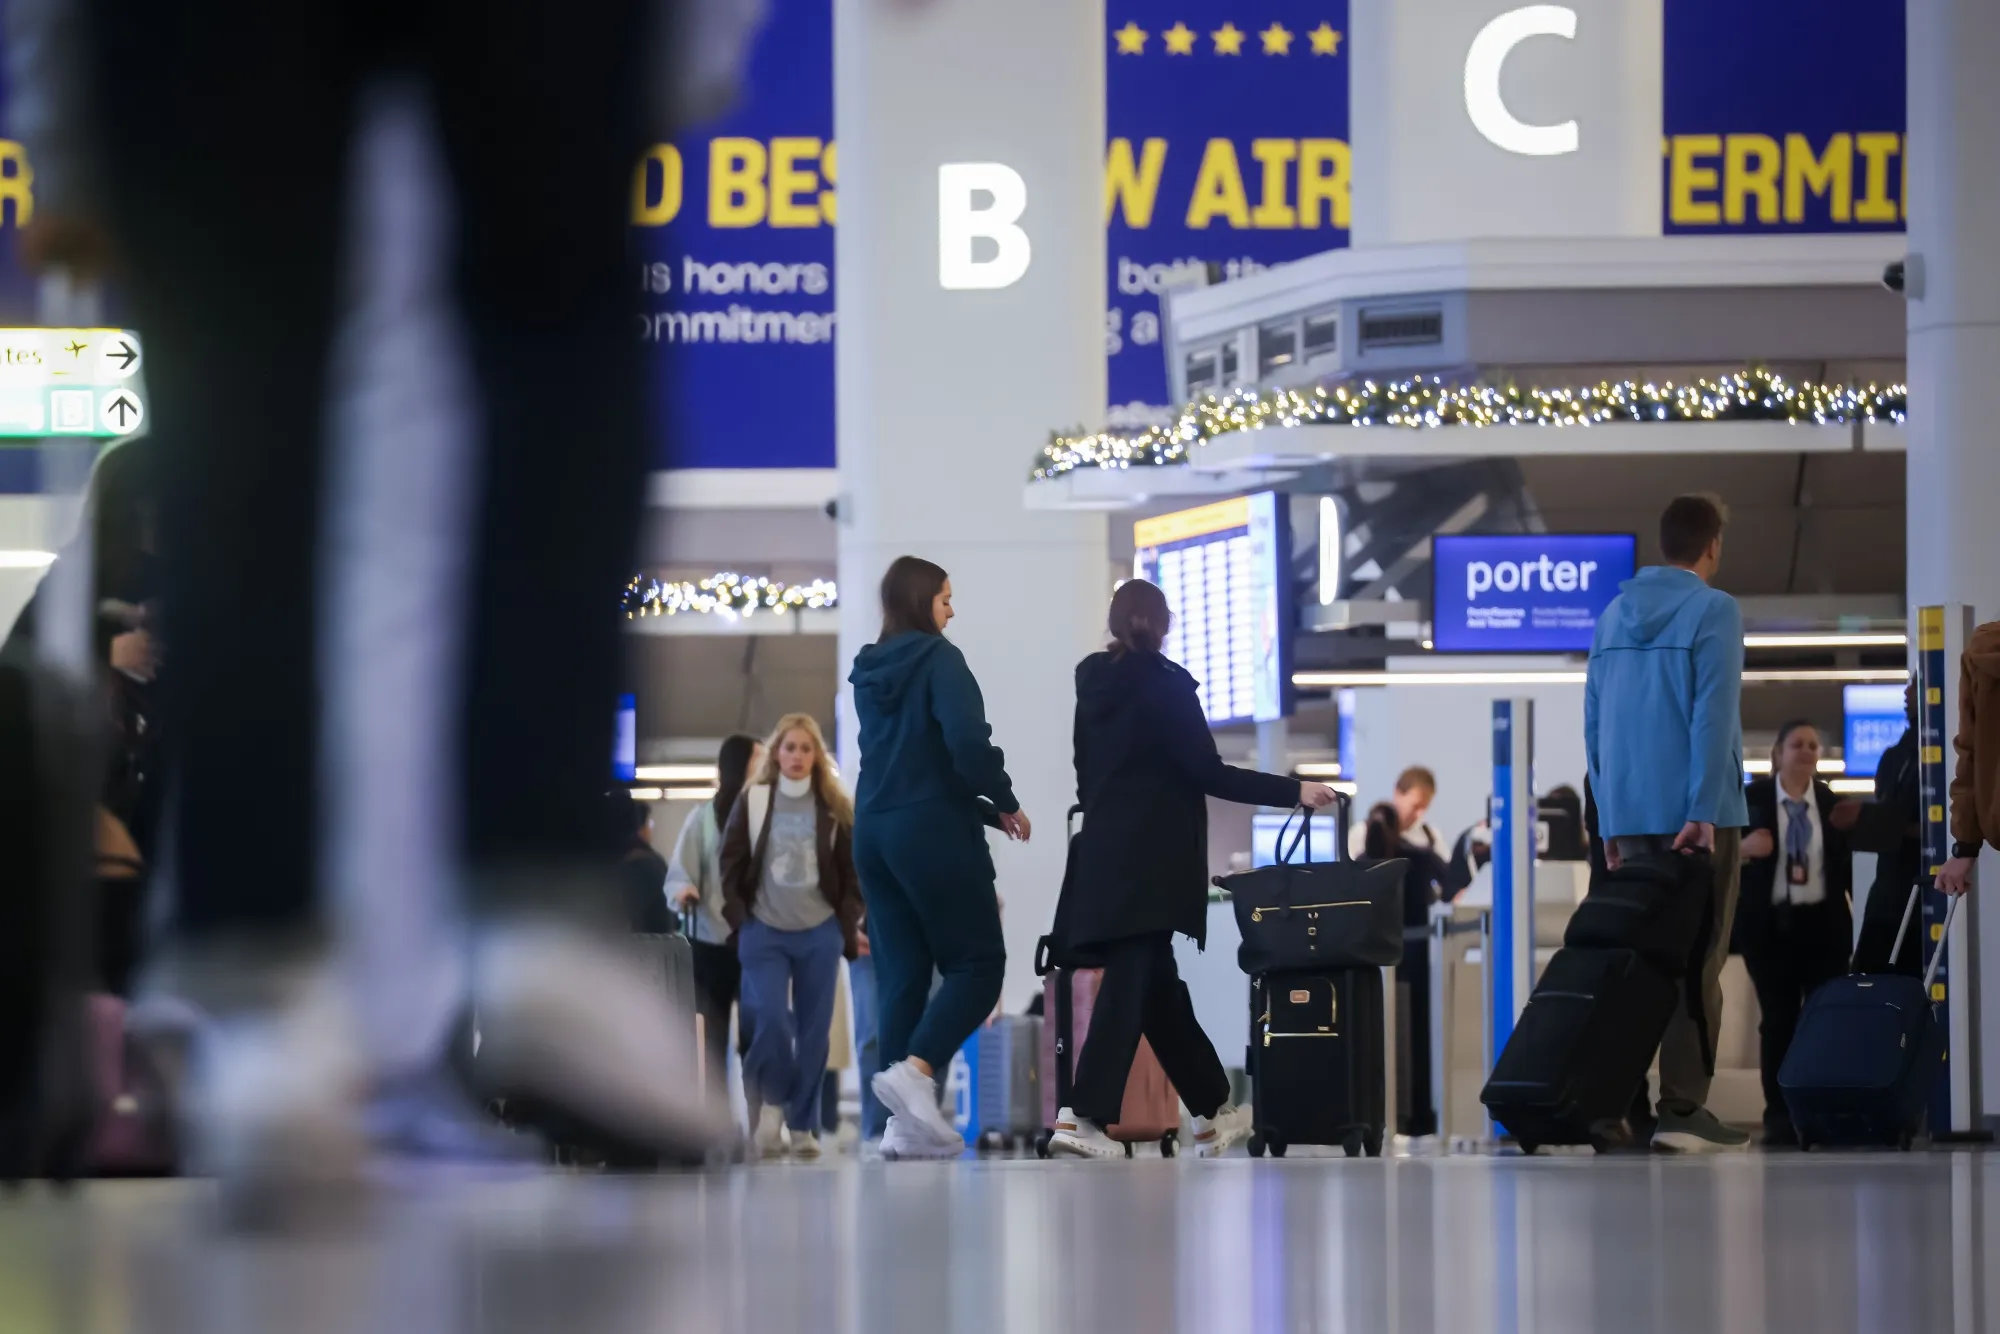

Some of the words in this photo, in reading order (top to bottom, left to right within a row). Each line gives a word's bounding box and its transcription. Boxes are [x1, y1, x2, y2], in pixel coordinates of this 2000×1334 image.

[1464, 5, 1579, 155] C
[939, 162, 1031, 290] B
[1185, 137, 1351, 229] AIR
[1662, 133, 1907, 225] ERMI
[684, 255, 828, 295] honors
[1466, 554, 1598, 601] porter
